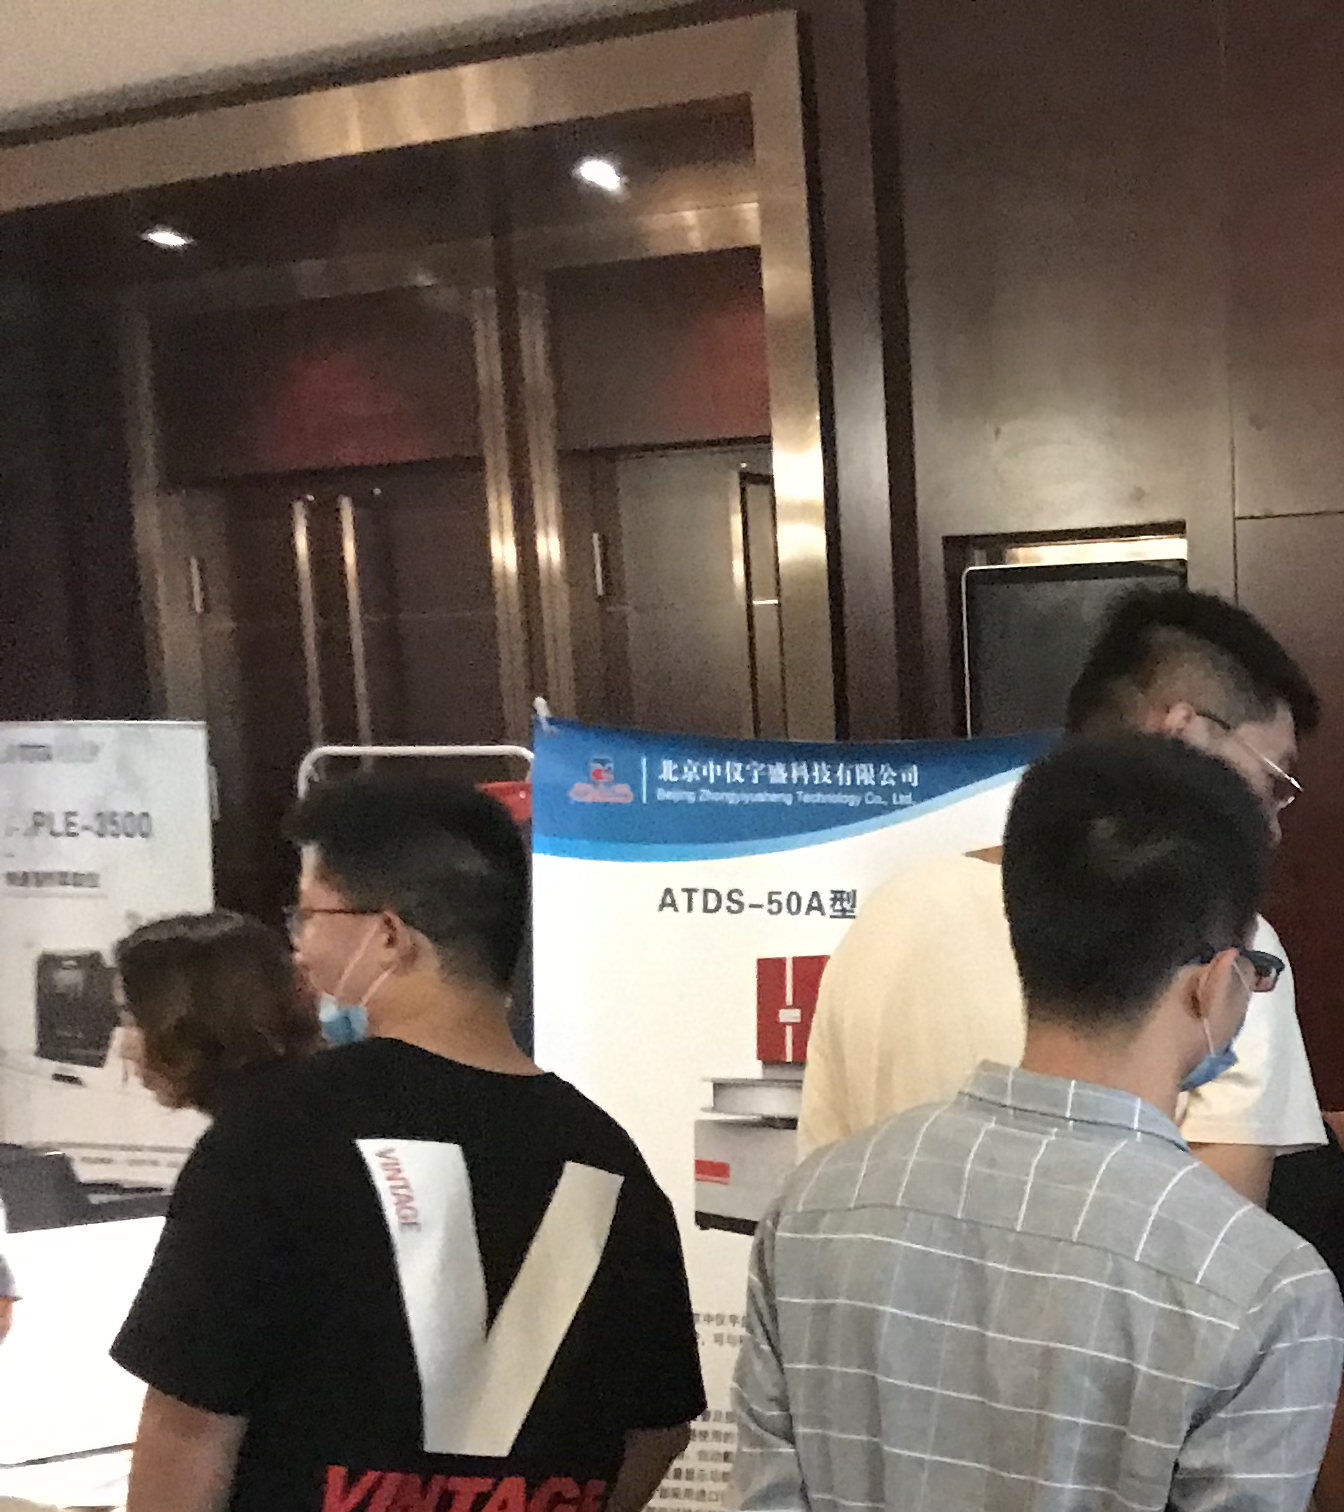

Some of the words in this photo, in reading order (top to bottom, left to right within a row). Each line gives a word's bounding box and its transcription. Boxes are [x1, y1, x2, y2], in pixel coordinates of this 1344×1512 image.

[658, 758, 919, 787] 北京中仪宇盛科技有限公司
[658, 887, 858, 919] ATDS-50A型
